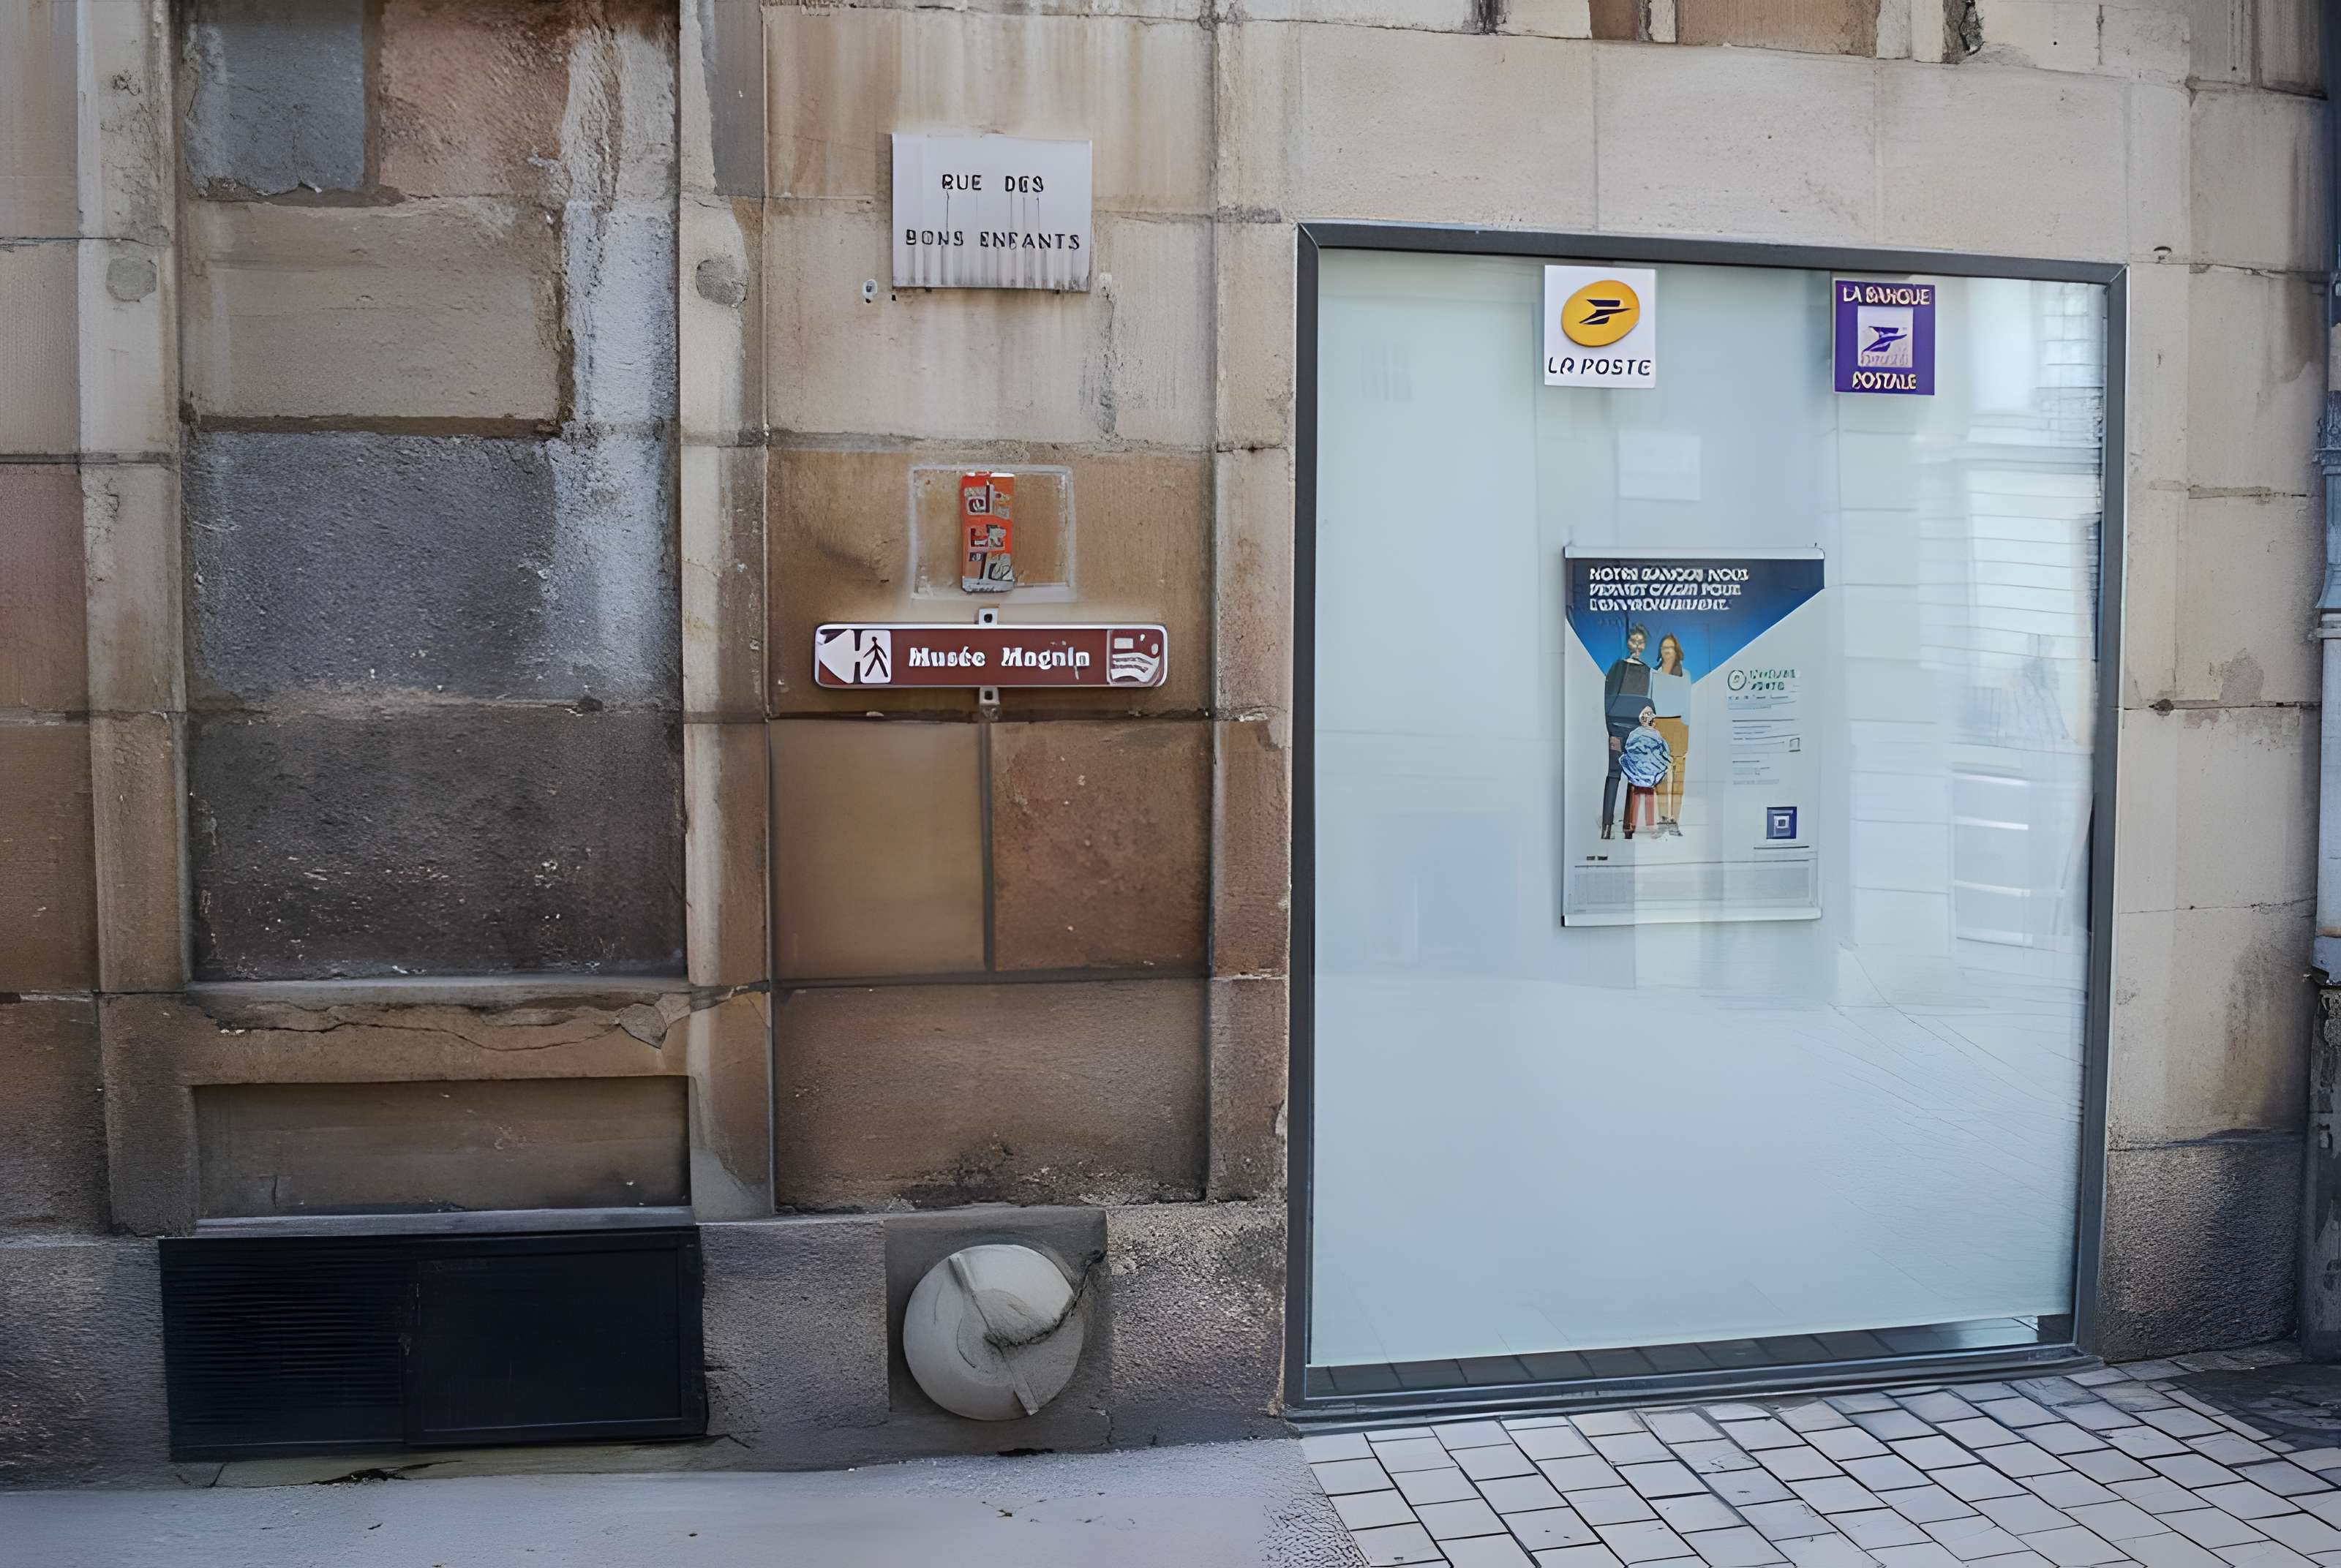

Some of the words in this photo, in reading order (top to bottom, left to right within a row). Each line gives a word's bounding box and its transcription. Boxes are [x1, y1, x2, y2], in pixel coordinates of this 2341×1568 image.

[942, 173, 982, 191] RUE
[906, 229, 964, 246] BONS
[980, 231, 1081, 250] ENFANTS
[1843, 285, 1863, 303] LA
[1548, 356, 1574, 375] LA
[1580, 358, 1652, 376] POSTE
[908, 646, 986, 667] Musée
[1001, 647, 1090, 670] Magnin
